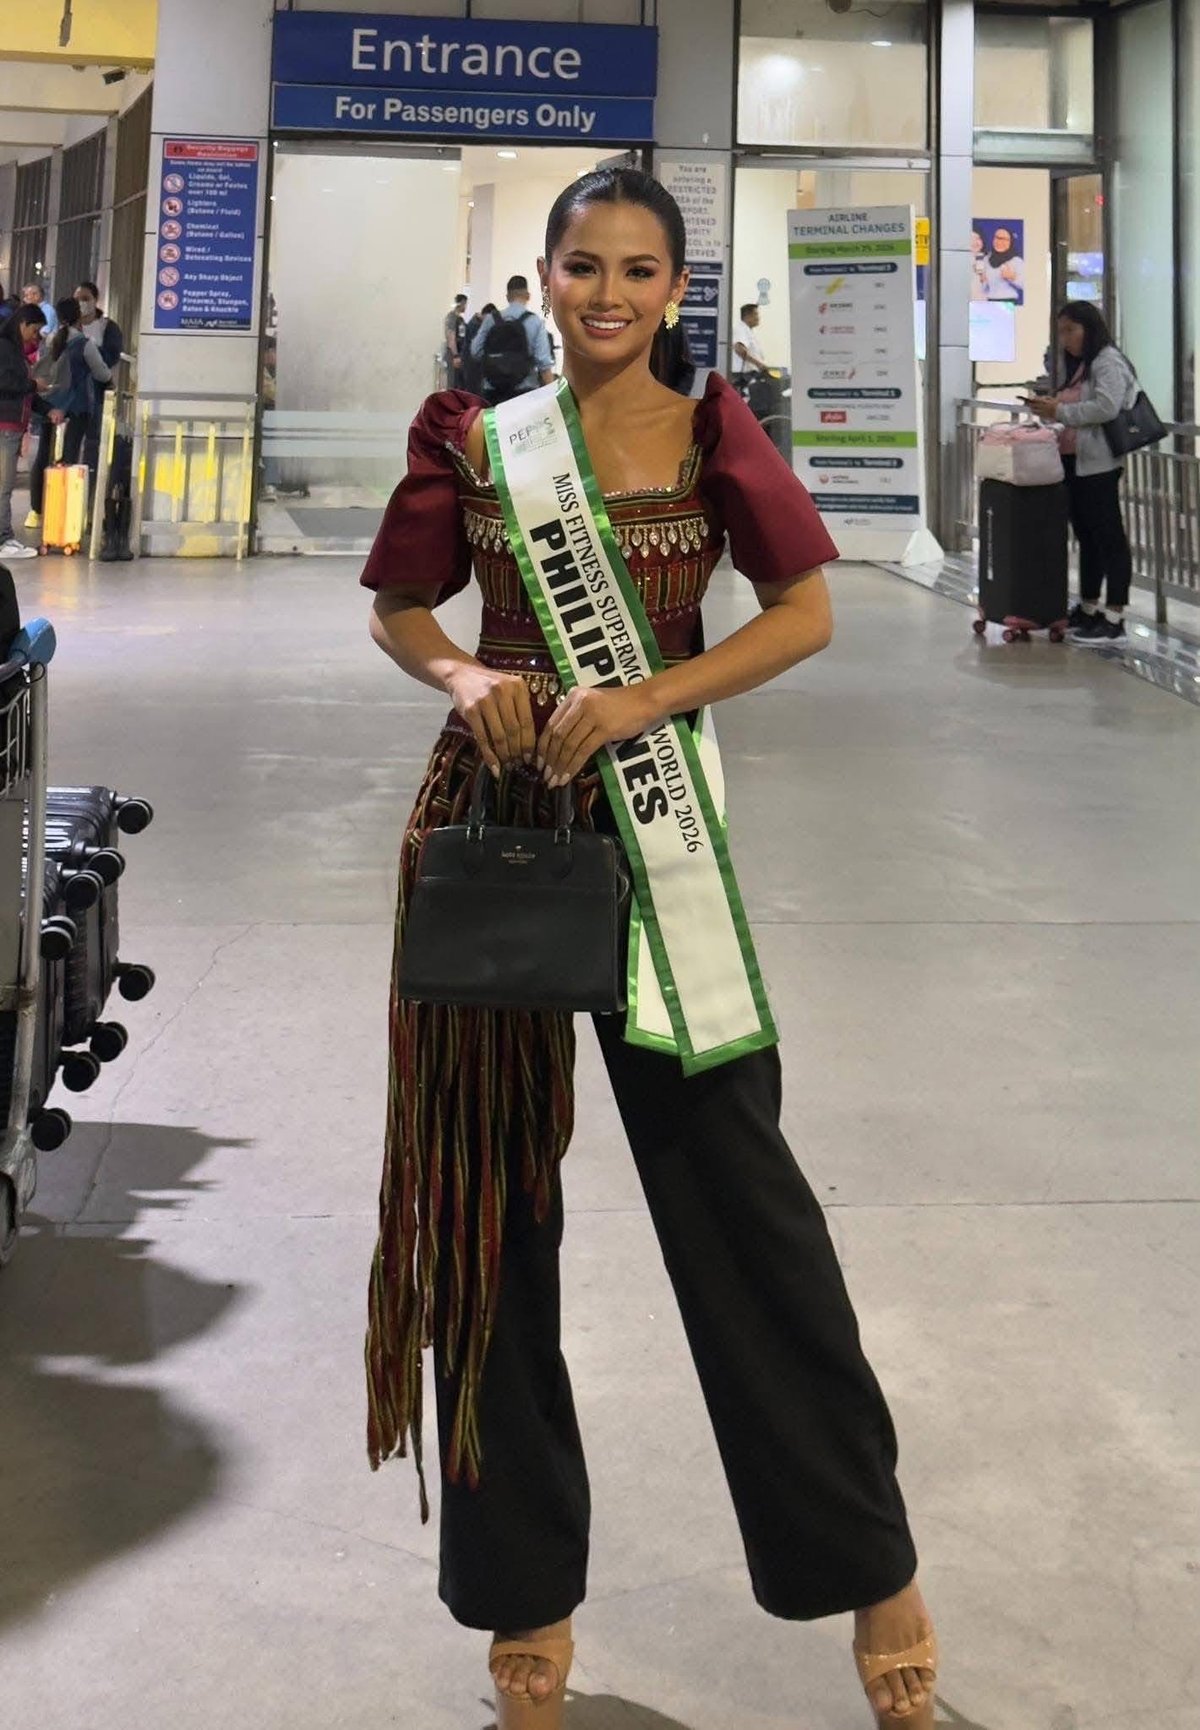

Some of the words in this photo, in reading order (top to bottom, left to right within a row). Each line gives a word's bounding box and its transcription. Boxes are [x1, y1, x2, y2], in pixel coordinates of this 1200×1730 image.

[351, 28, 582, 79] Entrance
[335, 96, 376, 119] For
[383, 98, 529, 129] Passengers
[535, 104, 597, 133] Only
[793, 225, 849, 236] TERMINAL
[852, 222, 905, 235] CHANGES
[828, 212, 868, 222] AIRLINE
[815, 434, 846, 444] Starting
[847, 434, 866, 443] April
[530, 518, 669, 825] PHILIPNES
[552, 472, 578, 513] MISS
[565, 514, 608, 594] FITNESS
[650, 724, 687, 801] WORLD
[675, 805, 705, 853] 2026
